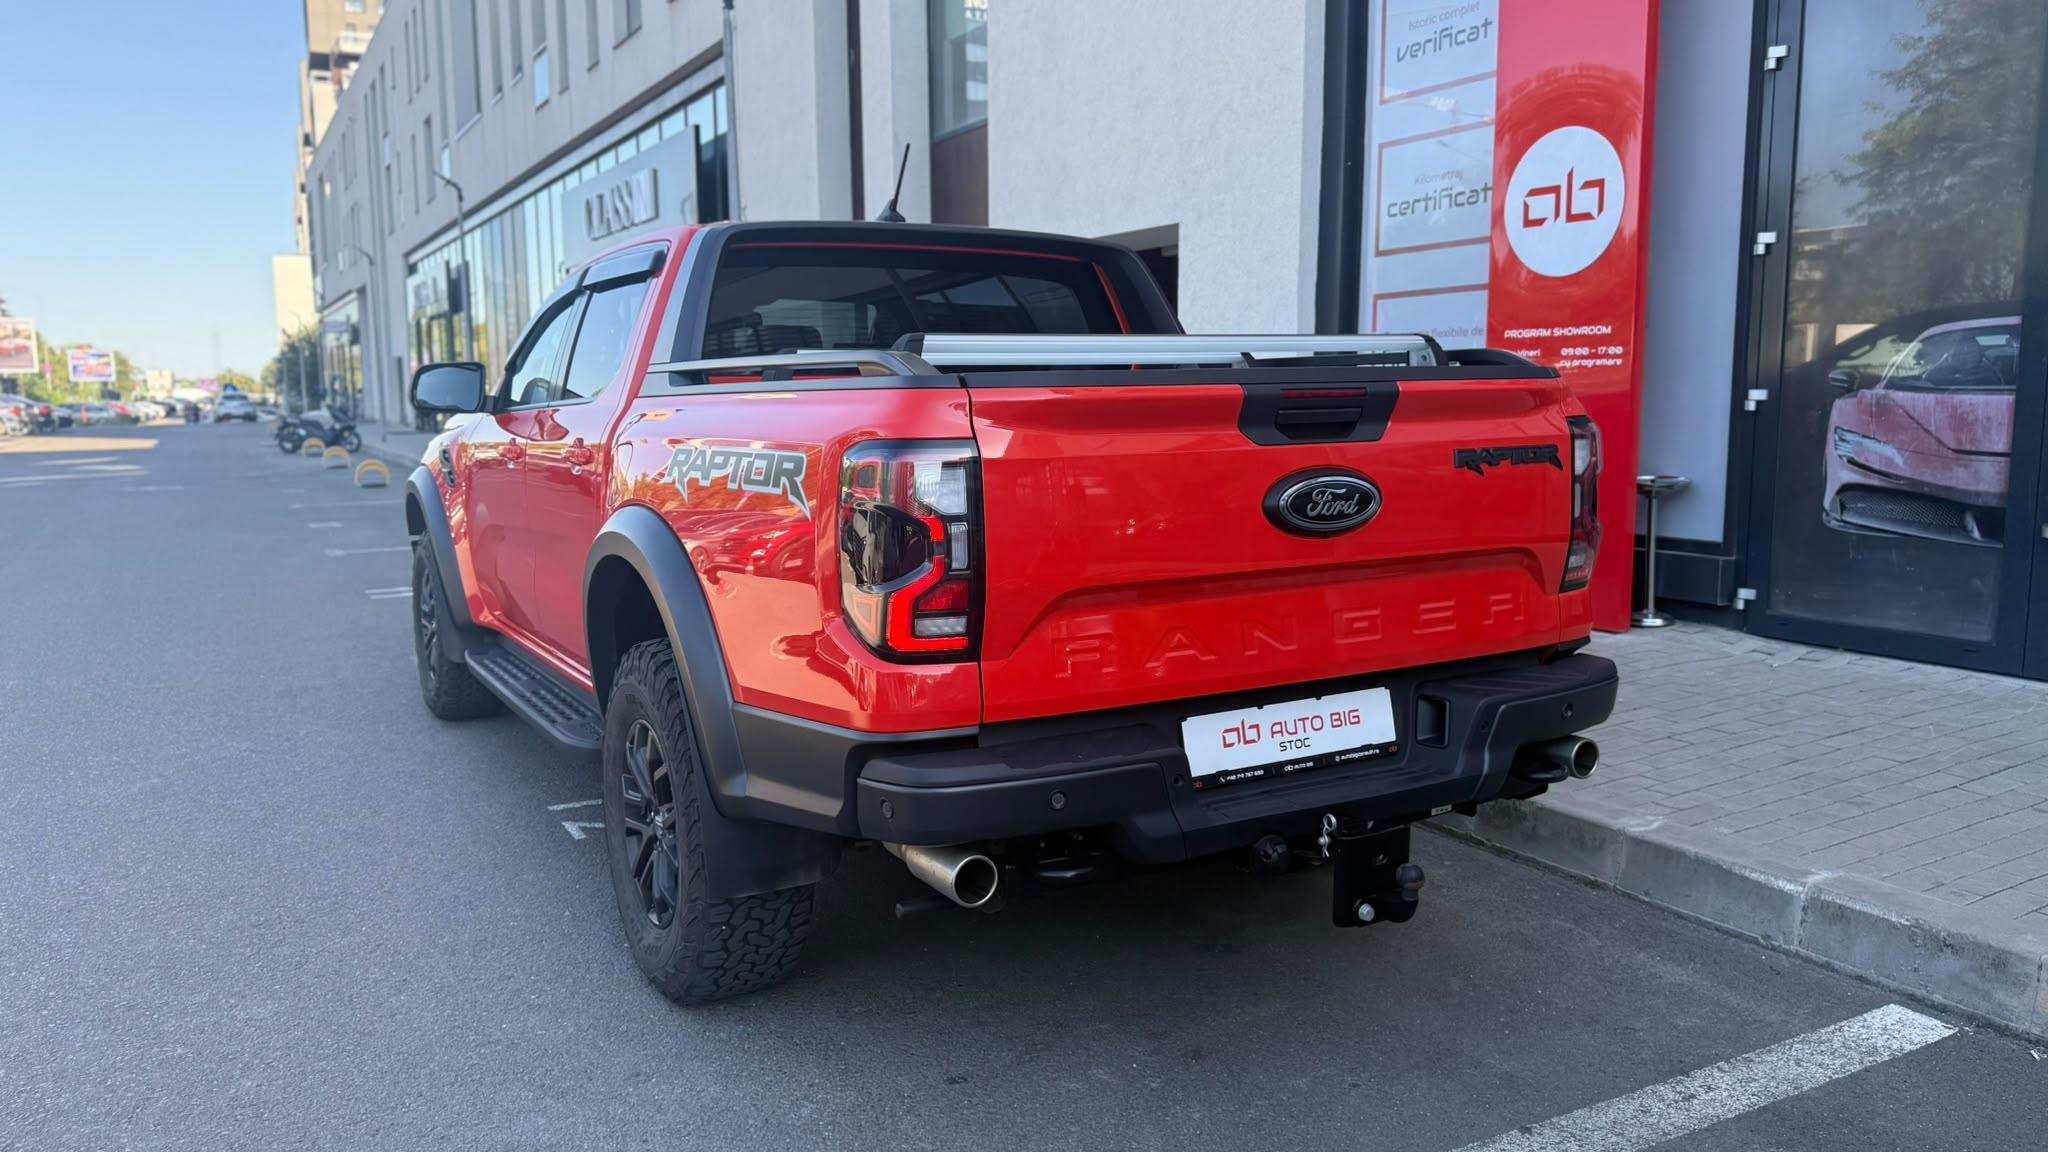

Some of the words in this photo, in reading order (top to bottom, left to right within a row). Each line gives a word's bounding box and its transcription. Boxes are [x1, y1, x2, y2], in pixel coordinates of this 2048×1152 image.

[1439, 1, 1480, 22] complet
[1396, 17, 1493, 63] verificat
[1387, 182, 1493, 218] certificat
[1504, 328, 1551, 339] PROGRAM
[1553, 325, 1612, 337] SHOWROOM
[1572, 358, 1622, 368] programare
[1454, 444, 1563, 477] RAPTOR
[664, 445, 812, 523] RAPTOR
[1306, 487, 1360, 518] Ford
[1055, 592, 1527, 680] RANGER
[1270, 715, 1325, 739] AUTO
[1329, 709, 1361, 729] BIG
[1279, 737, 1311, 752] STOC
